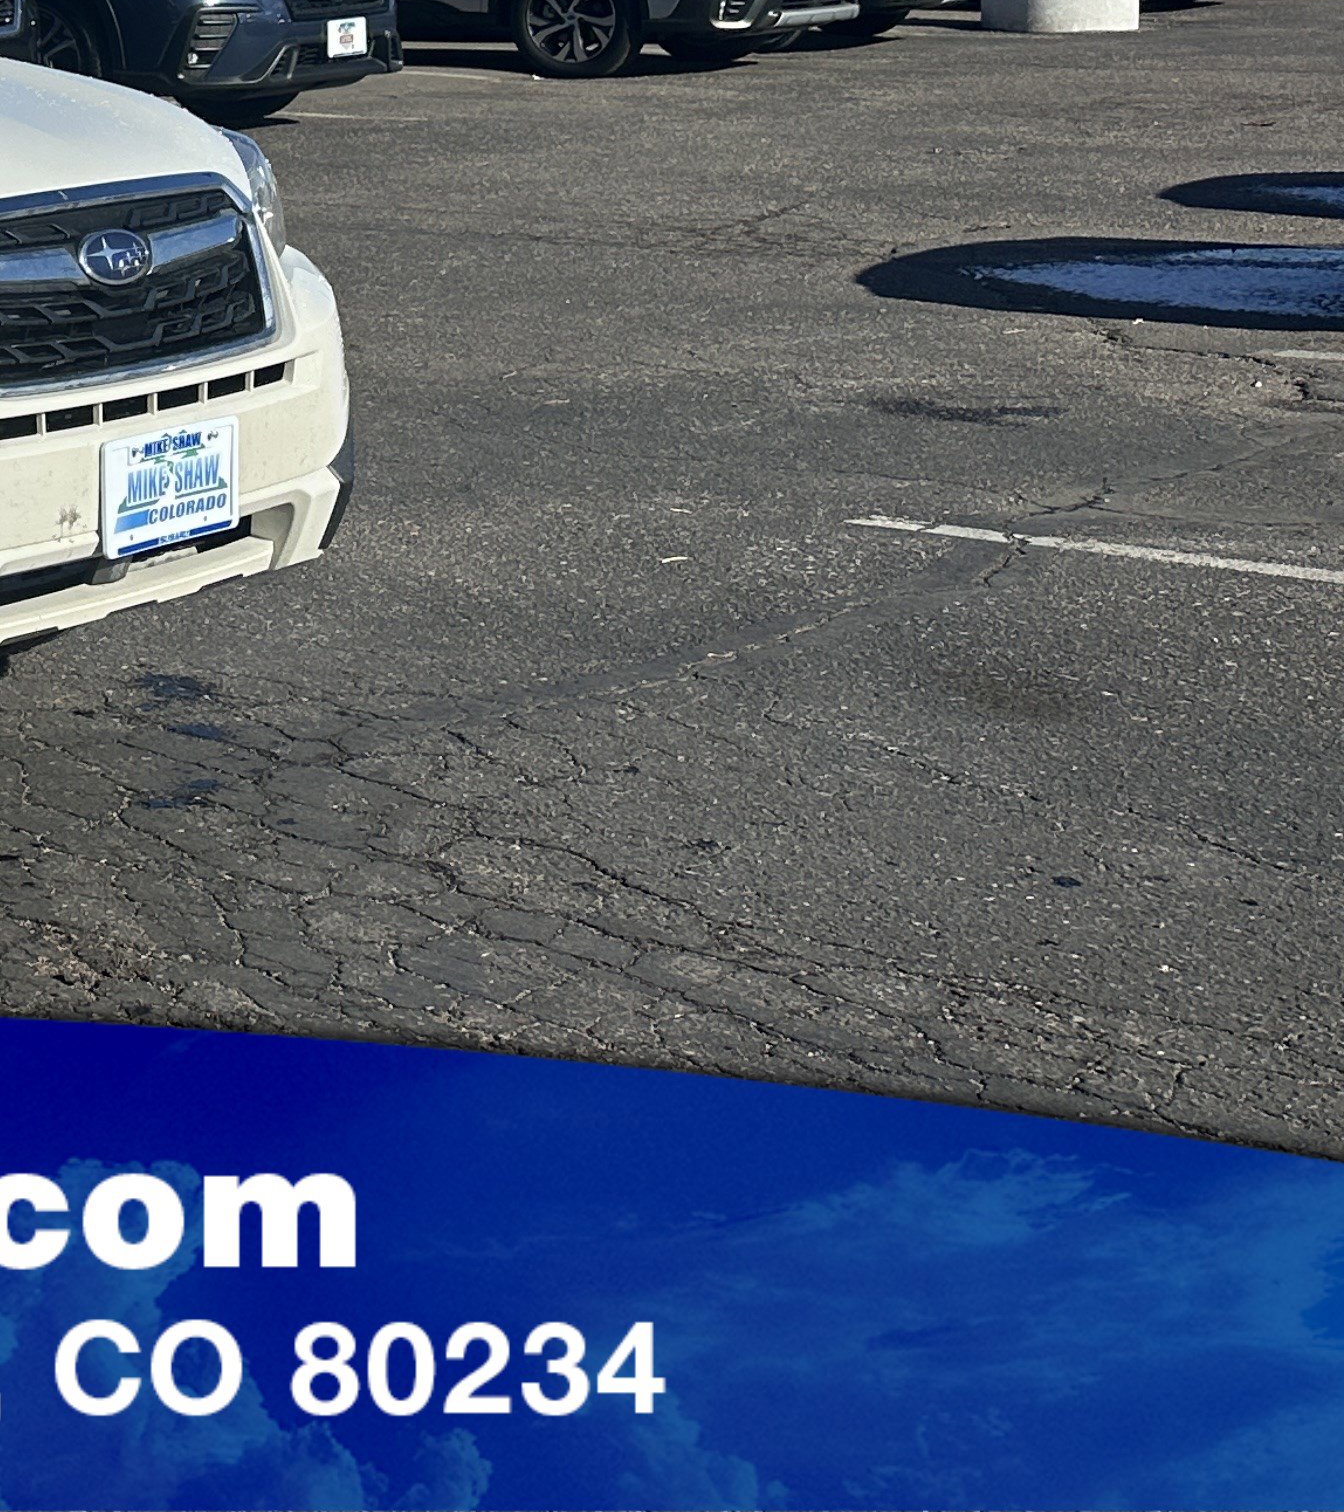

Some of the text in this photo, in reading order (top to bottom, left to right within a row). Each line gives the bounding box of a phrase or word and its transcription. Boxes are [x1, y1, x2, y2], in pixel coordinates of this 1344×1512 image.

[144, 432, 202, 457] MIKE SHAW
[127, 453, 220, 504] MIKE SHAW
[149, 493, 227, 524] COLORADO
